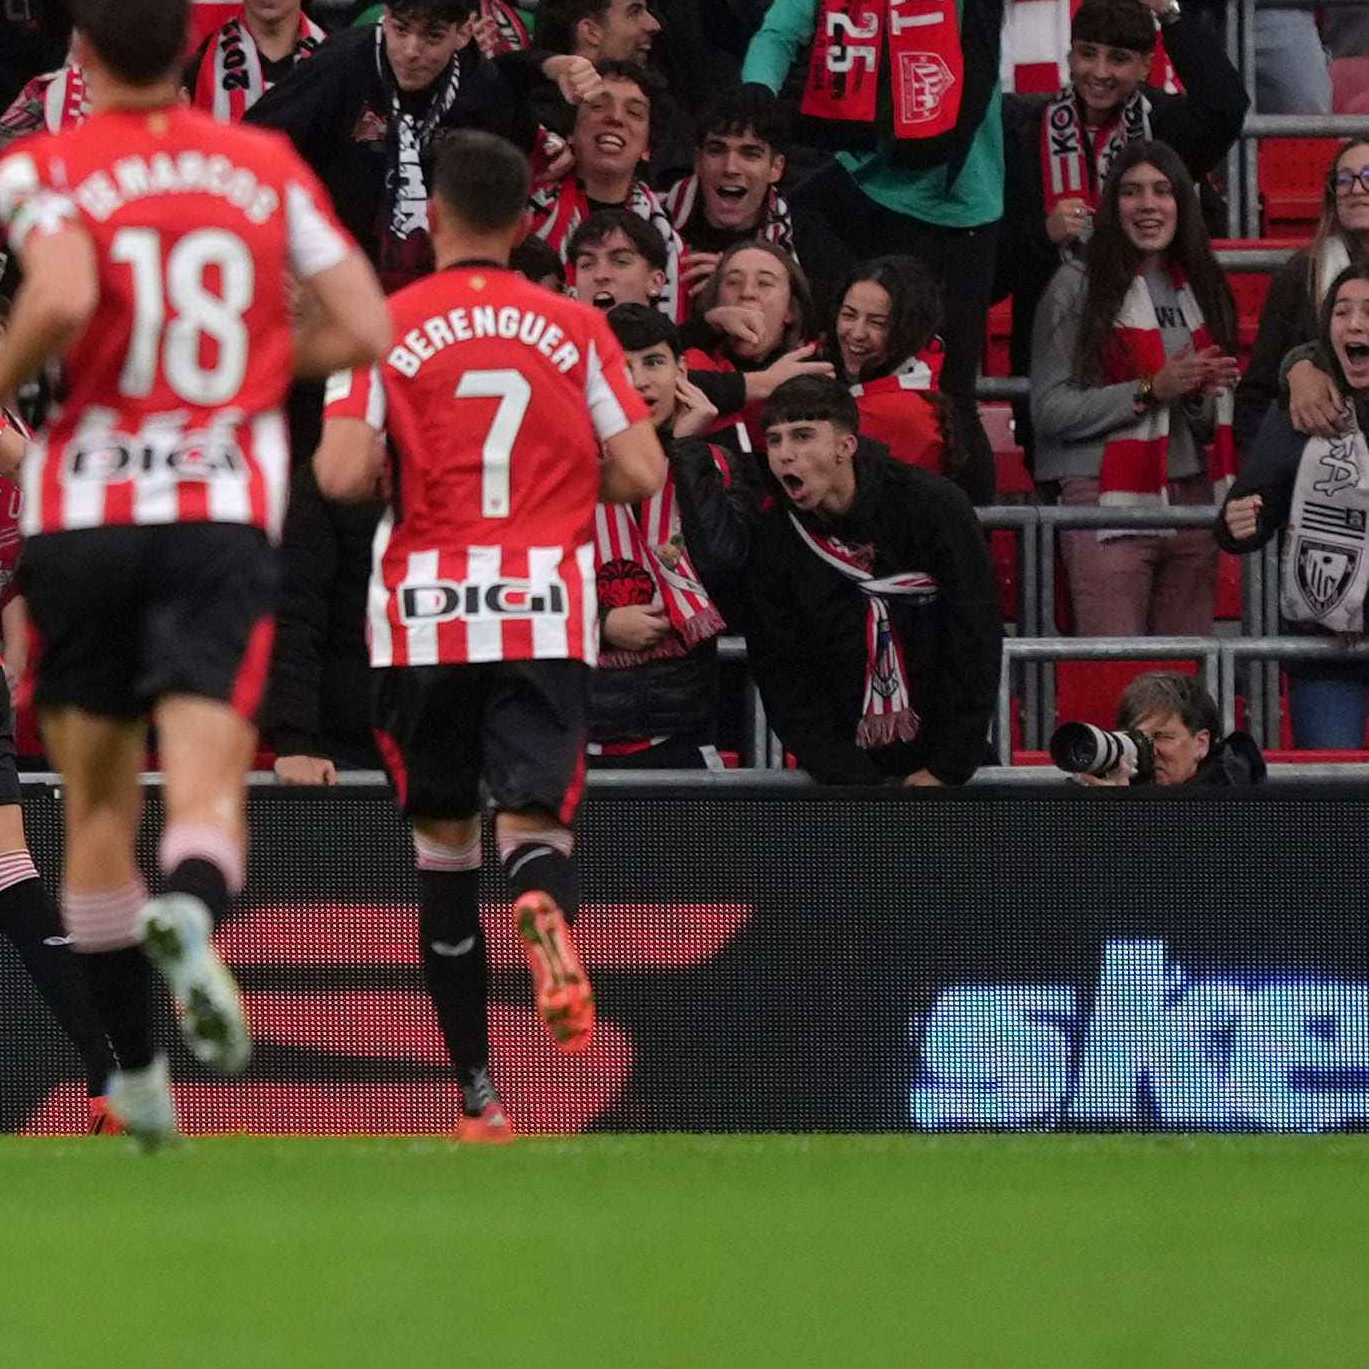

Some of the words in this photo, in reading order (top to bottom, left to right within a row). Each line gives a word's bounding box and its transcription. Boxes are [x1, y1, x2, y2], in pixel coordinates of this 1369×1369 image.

[111, 227, 256, 407] 18
[387, 305, 581, 379] BERENGUER
[454, 367, 532, 519] 7
[402, 583, 565, 620] DIGI
